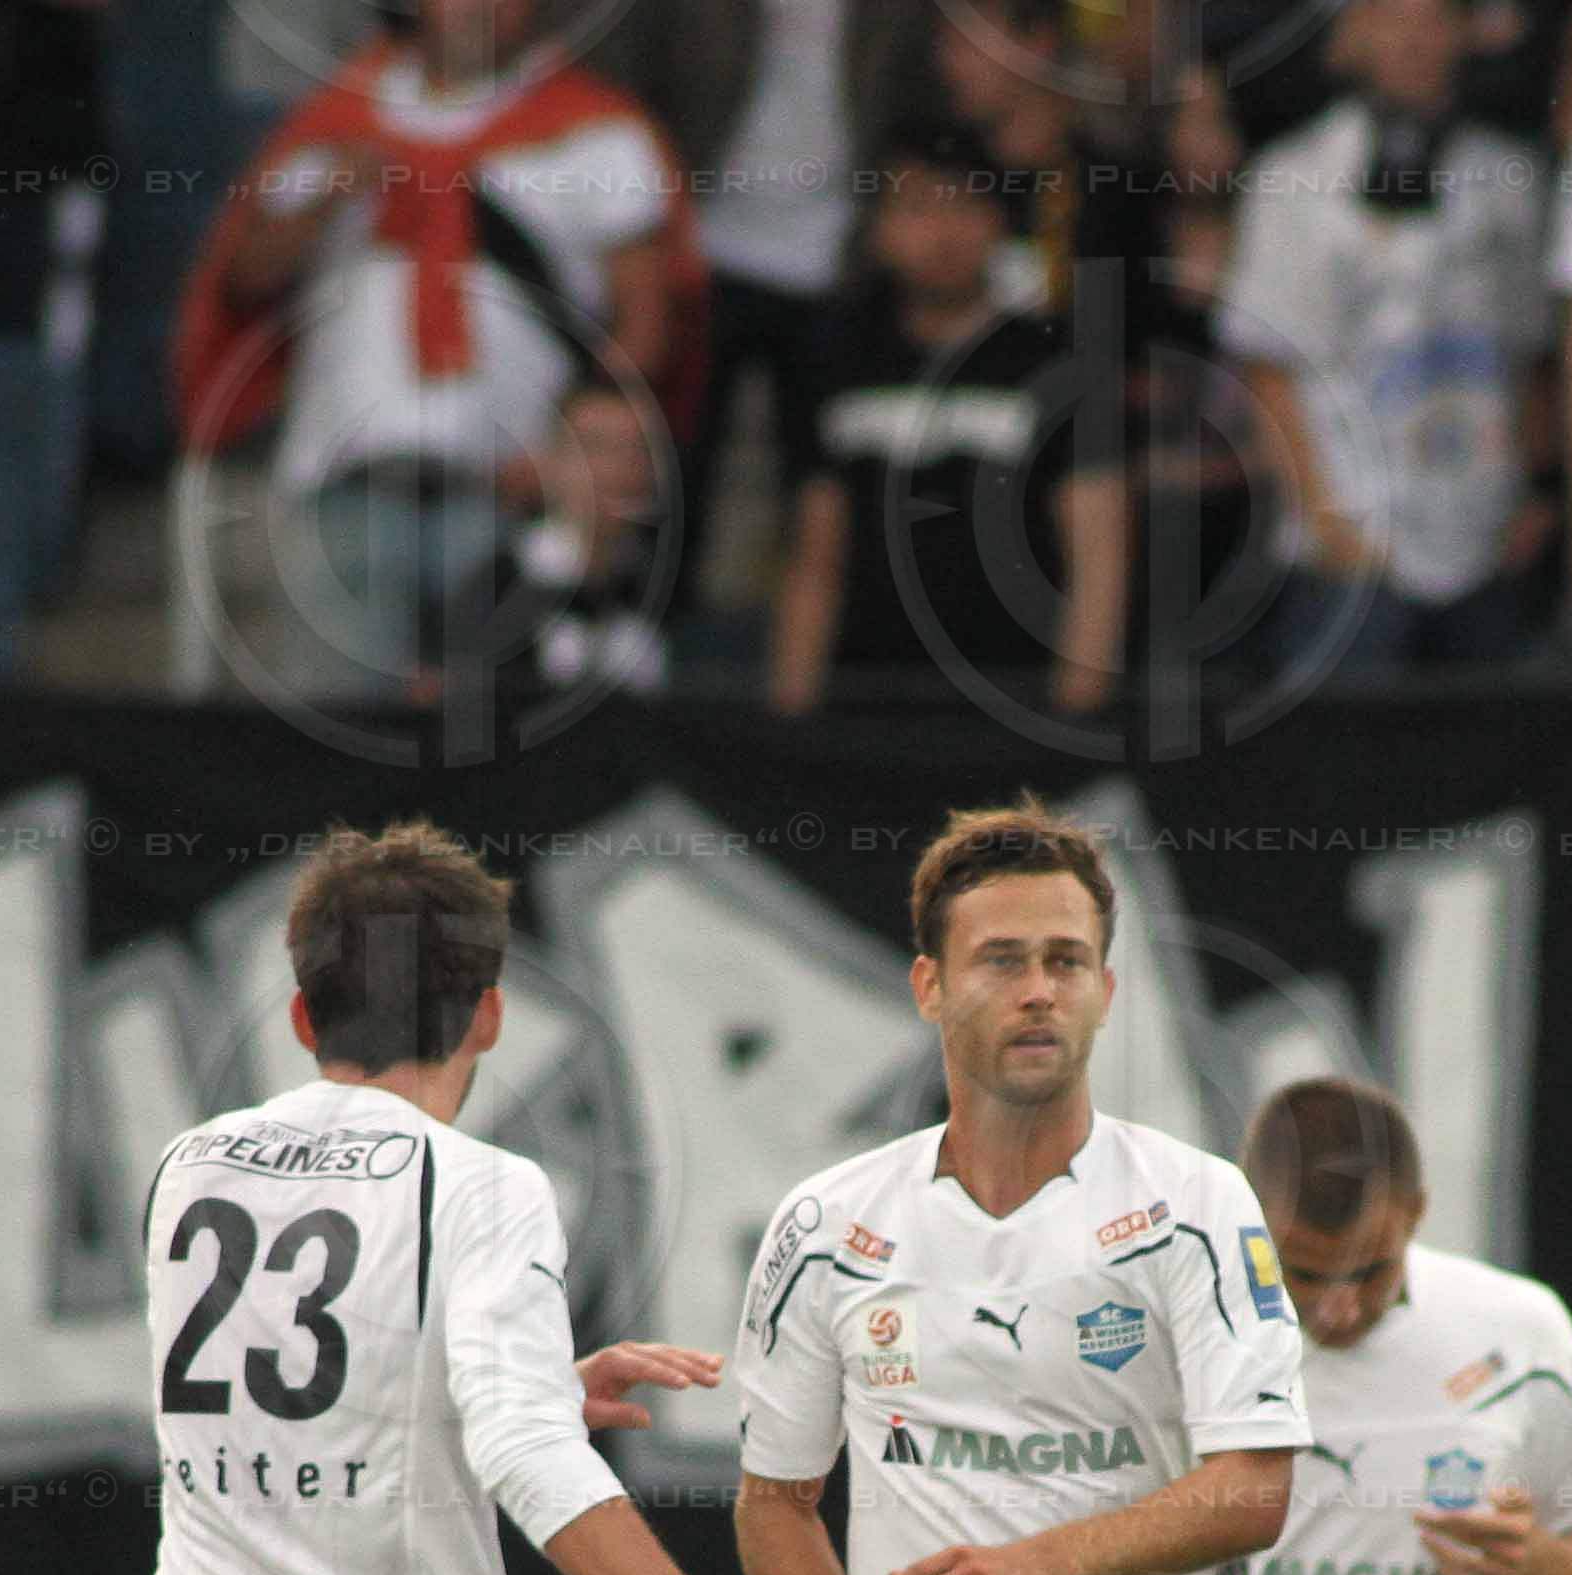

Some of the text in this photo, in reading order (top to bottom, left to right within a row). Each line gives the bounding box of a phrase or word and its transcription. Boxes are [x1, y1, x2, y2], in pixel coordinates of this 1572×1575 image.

[181, 1134, 364, 1172] PIPELINES
[161, 1197, 360, 1420] 23
[865, 1366, 917, 1387] LIGA
[162, 1447, 367, 1498] eiter
[928, 1427, 1145, 1474] MAGNA
